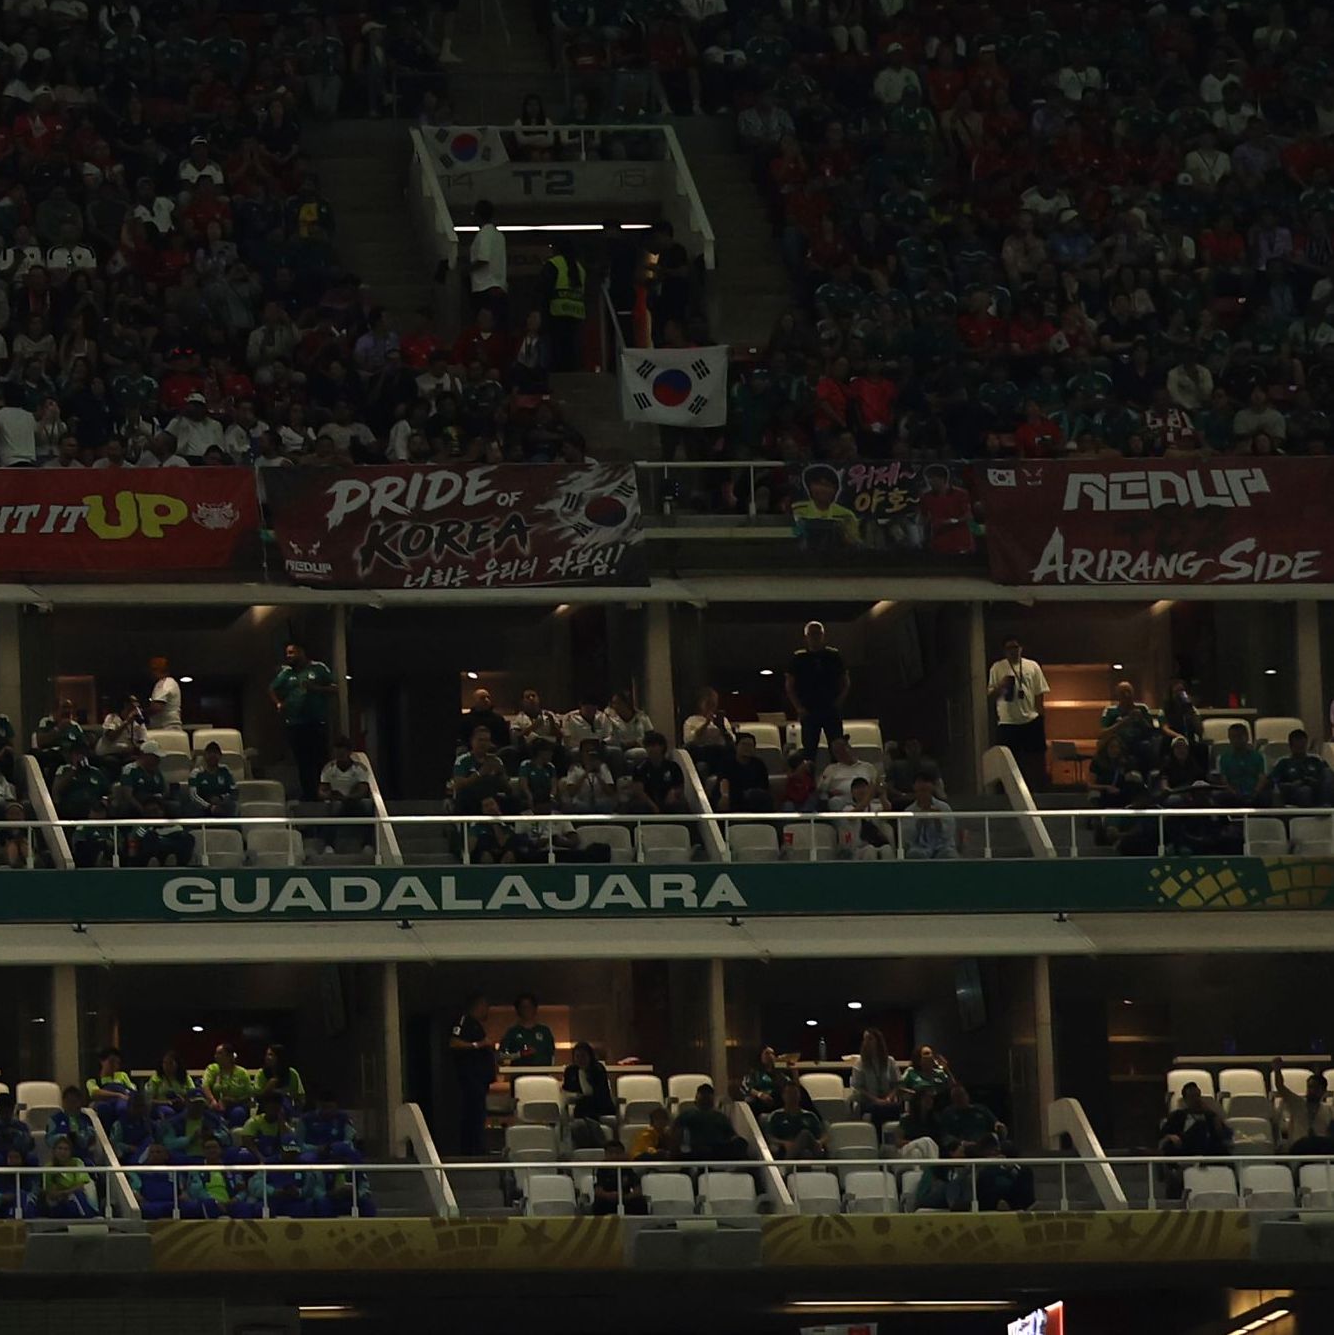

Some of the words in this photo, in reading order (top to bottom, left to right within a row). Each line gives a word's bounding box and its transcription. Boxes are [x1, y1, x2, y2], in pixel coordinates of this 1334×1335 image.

[512, 170, 575, 195] T2
[39, 505, 90, 534] IT
[83, 490, 189, 540] UP
[326, 467, 499, 531] PRIDE
[496, 491, 523, 507] OF
[354, 514, 532, 578] KOREA
[403, 565, 470, 589] 너희는
[477, 556, 539, 586] 우리의
[546, 544, 625, 577] 자부심!
[1030, 526, 1215, 584] ARIRANG
[1209, 537, 1323, 583] SIDE
[162, 873, 748, 913] GUADALAJARA
